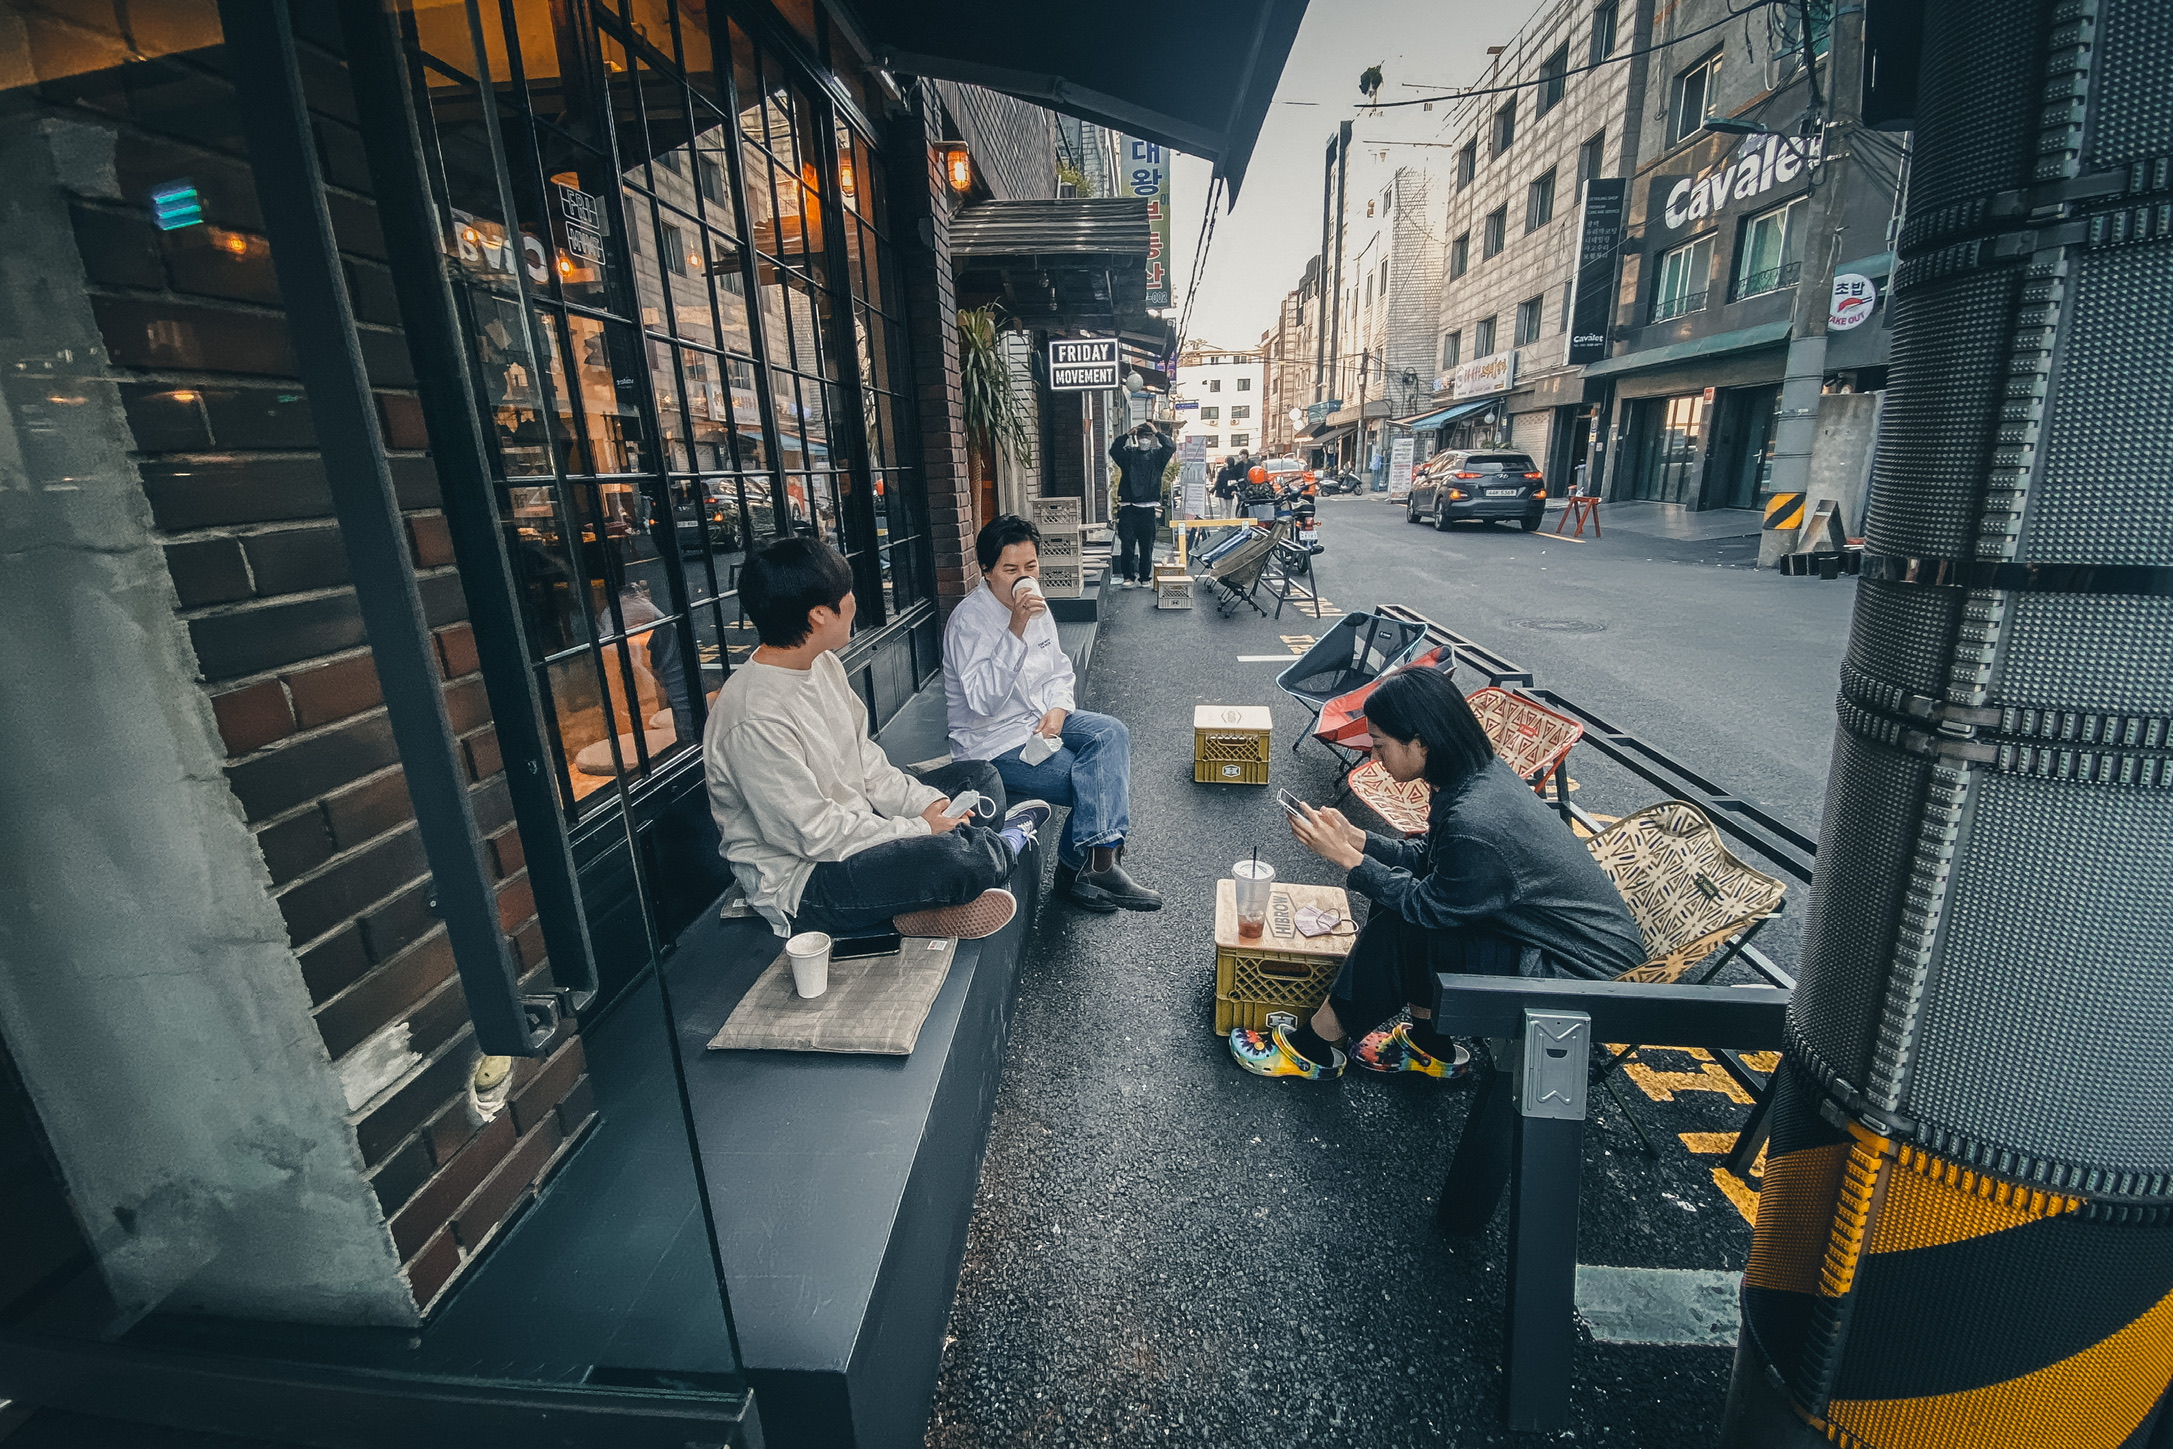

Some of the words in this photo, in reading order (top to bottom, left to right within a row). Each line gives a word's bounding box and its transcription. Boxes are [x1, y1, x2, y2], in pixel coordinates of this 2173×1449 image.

[1834, 281, 1865, 296] 초밥
[1847, 312, 1865, 324] OUT
[1058, 344, 1109, 362] FRIDAY
[1055, 368, 1113, 384] MOVEMENT
[1272, 895, 1292, 935] HIBROW
